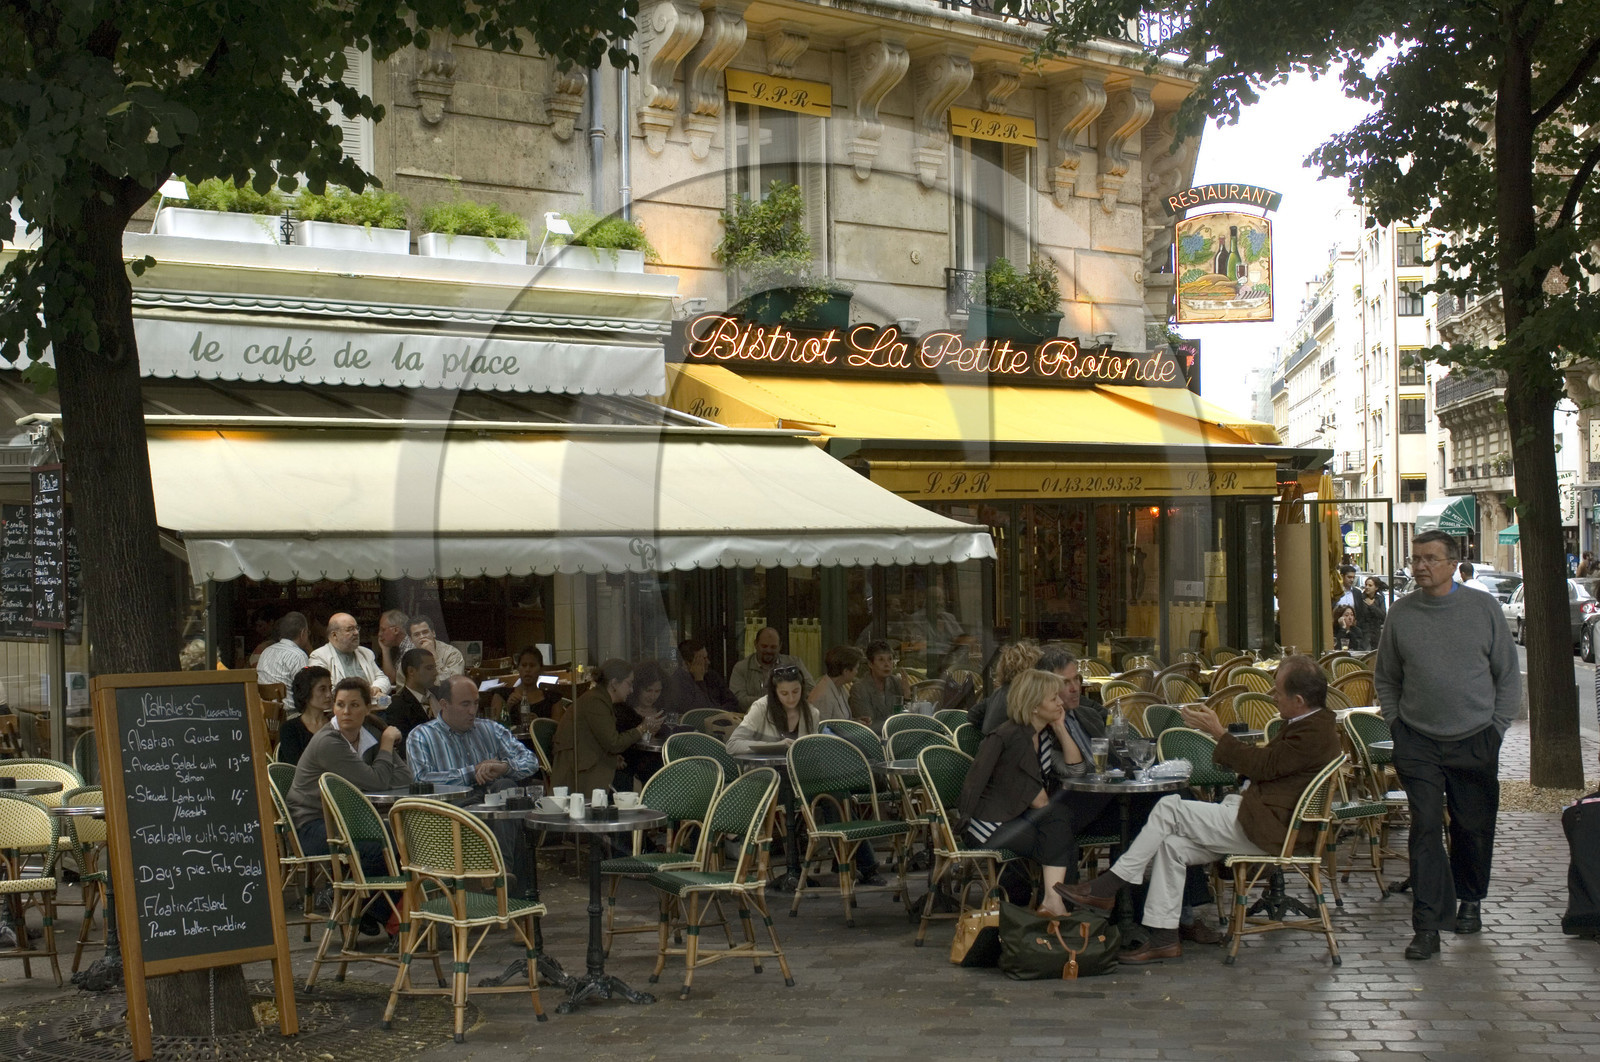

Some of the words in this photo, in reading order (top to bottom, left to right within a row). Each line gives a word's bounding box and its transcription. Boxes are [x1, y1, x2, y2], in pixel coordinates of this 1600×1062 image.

[1168, 184, 1276, 212] RESTAURANT
[188, 330, 224, 364] le
[243, 335, 317, 373] café
[333, 340, 371, 370] de
[391, 341, 425, 372] la
[441, 345, 521, 379] place
[688, 315, 840, 364] Bistrot
[848, 325, 912, 369] La
[920, 332, 1031, 375] Petite
[1039, 340, 1177, 383] Rotonde
[688, 398, 723, 418] Bar
[1040, 476, 1143, 493] 01.43.20.93.52
[231, 729, 243, 741] 10
[131, 756, 170, 772] Avocado
[171, 753, 198, 771] Salad
[200, 757, 217, 770] with
[197, 787, 216, 802] with
[195, 822, 218, 843] with
[139, 866, 182, 889] Day's
[234, 855, 262, 876] Salad
